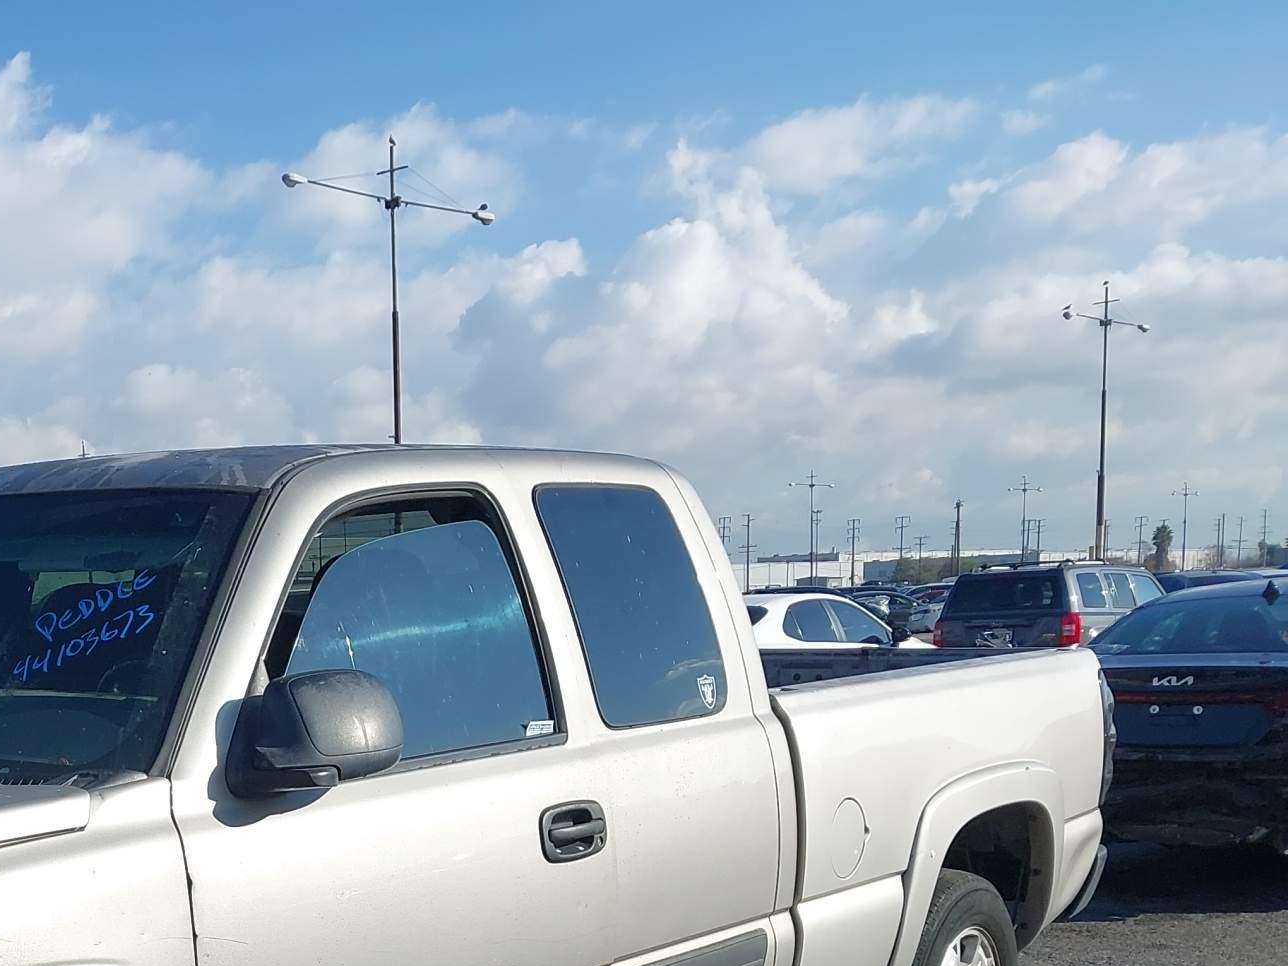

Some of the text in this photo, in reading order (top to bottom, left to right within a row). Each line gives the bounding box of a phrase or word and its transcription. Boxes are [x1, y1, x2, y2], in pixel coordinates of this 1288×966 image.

[34, 568, 157, 642] PEDDLE
[12, 604, 154, 681] 44103673
[1151, 675, 1194, 686] KIA
